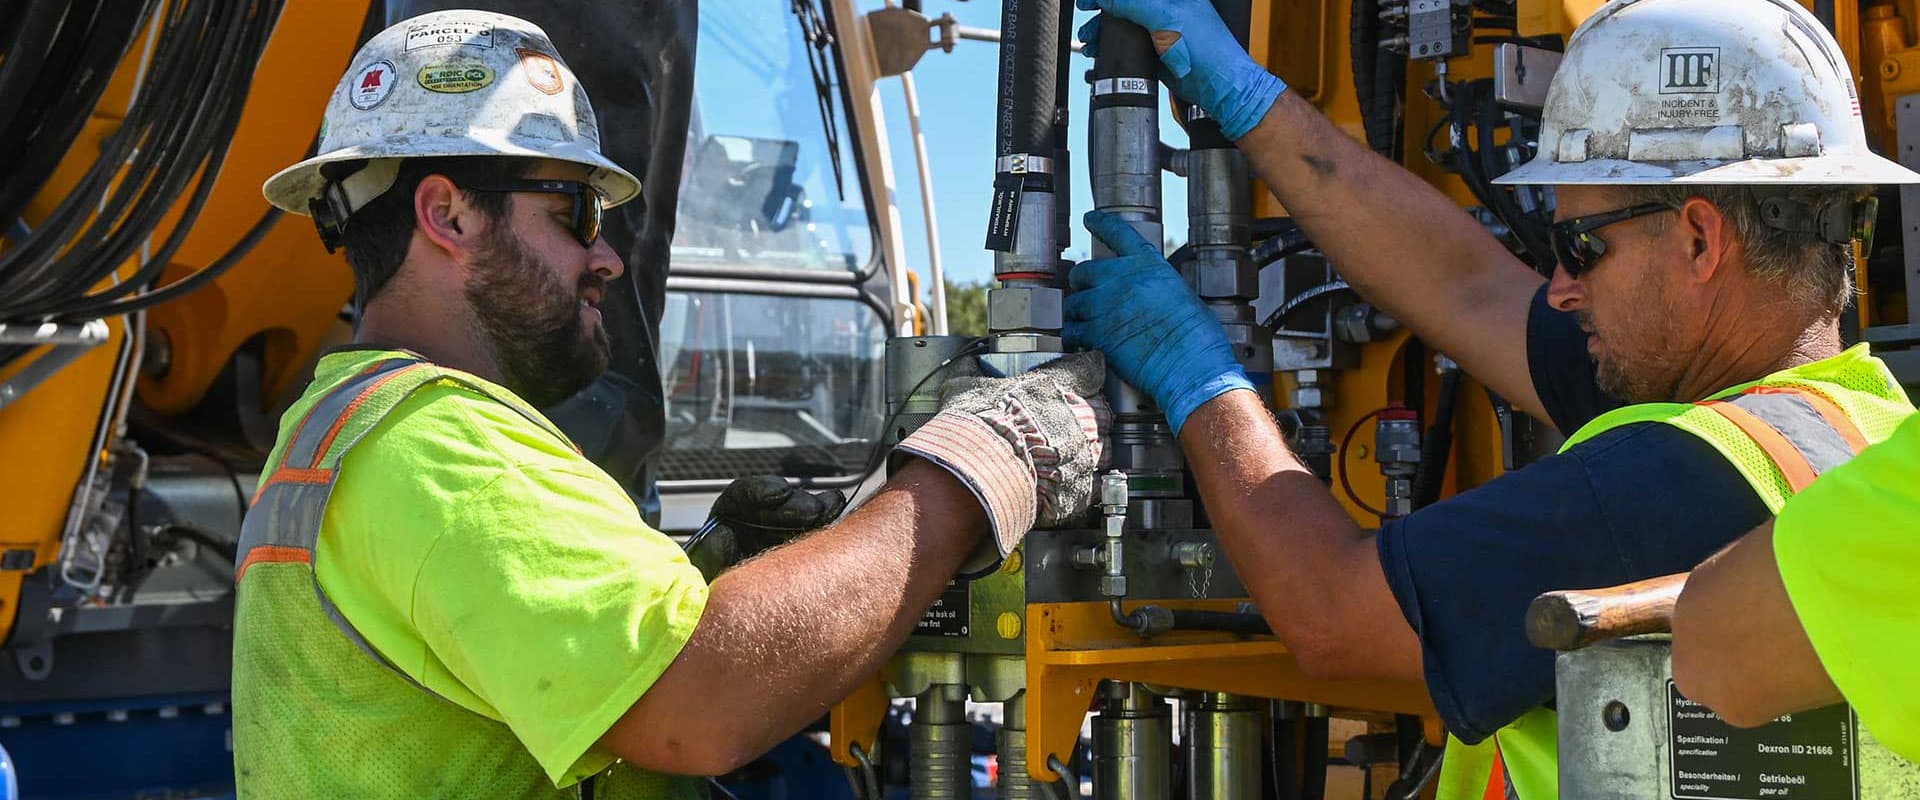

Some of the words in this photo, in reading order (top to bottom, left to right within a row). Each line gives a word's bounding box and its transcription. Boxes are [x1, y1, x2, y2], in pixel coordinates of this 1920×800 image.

[1008, 14, 1017, 39] BAR
[410, 28, 472, 40] PARCEL
[437, 34, 462, 43] 053
[1665, 53, 1713, 88] IIF
[1131, 80, 1146, 91] B2
[1661, 99, 1705, 108] INCIDENT
[1708, 99, 1715, 108] &
[1657, 109, 1719, 118] INJURY-FREE
[930, 619, 940, 628] first
[1677, 711, 1706, 719] hydraulic
[1677, 734, 1724, 745] Spezifikation
[1678, 748, 1718, 757] specification
[1758, 743, 1790, 754] Dexron
[1806, 745, 1833, 755] 21666
[1679, 770, 1737, 782] Besonderheiten
[1759, 773, 1805, 785] Getriebeöl
[1760, 788, 1777, 796] gear
[1778, 787, 1789, 796] oil
